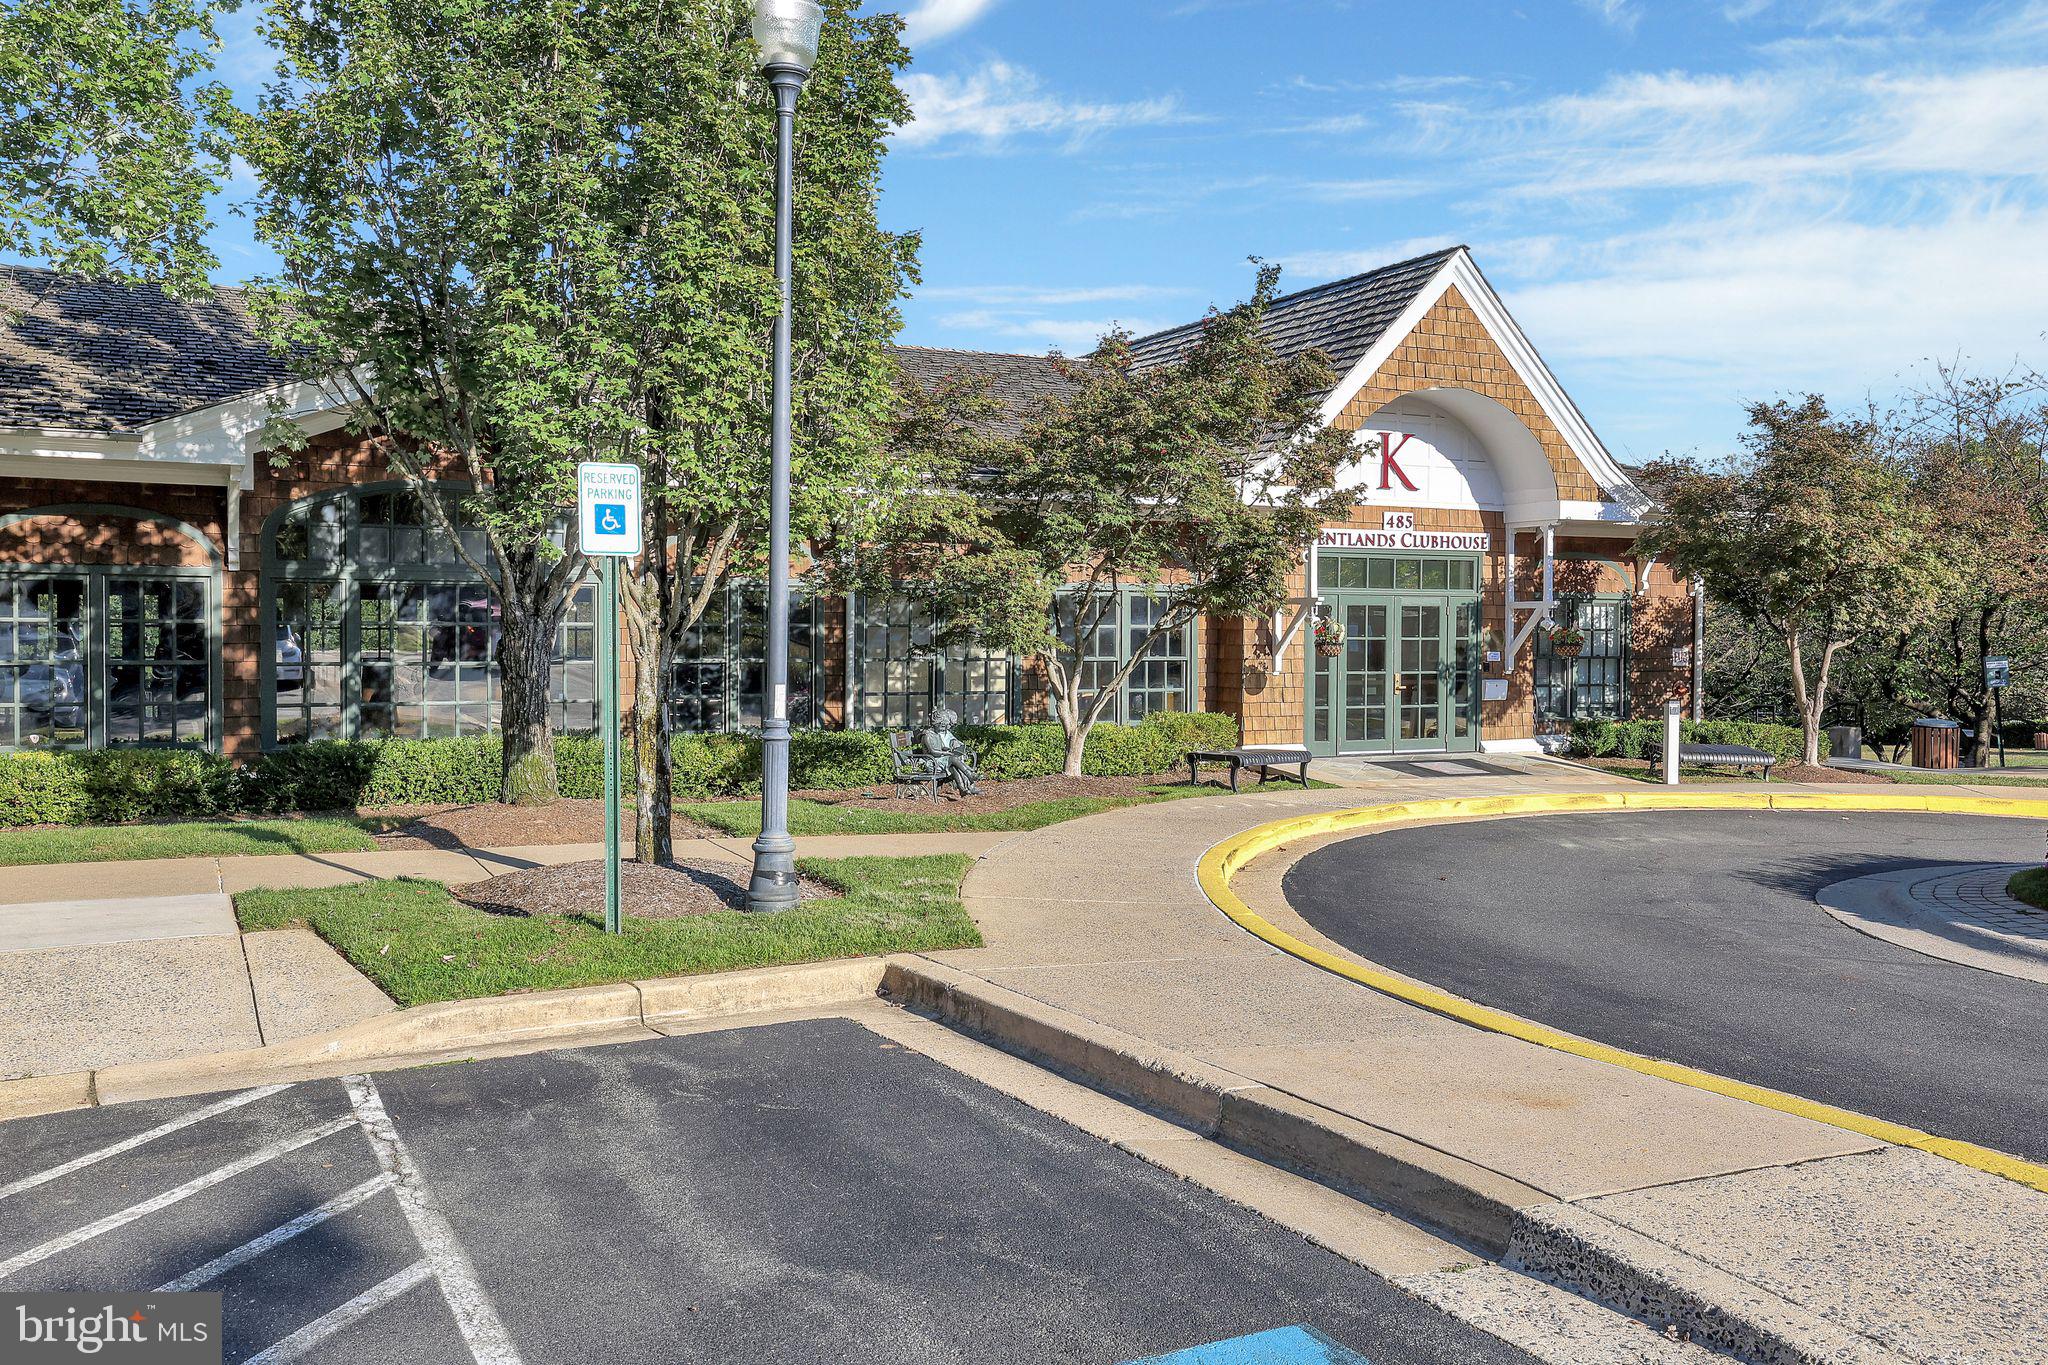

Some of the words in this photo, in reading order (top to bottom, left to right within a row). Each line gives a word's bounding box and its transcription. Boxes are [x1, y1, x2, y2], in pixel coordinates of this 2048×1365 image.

[1376, 432, 1420, 491] K
[583, 472, 636, 485] RESERVED
[587, 487, 632, 500] PARKING
[1386, 515, 1413, 529] 485
[1316, 530, 1396, 547] ENTLANDS
[1400, 532, 1488, 550] CLUBHOUSE
